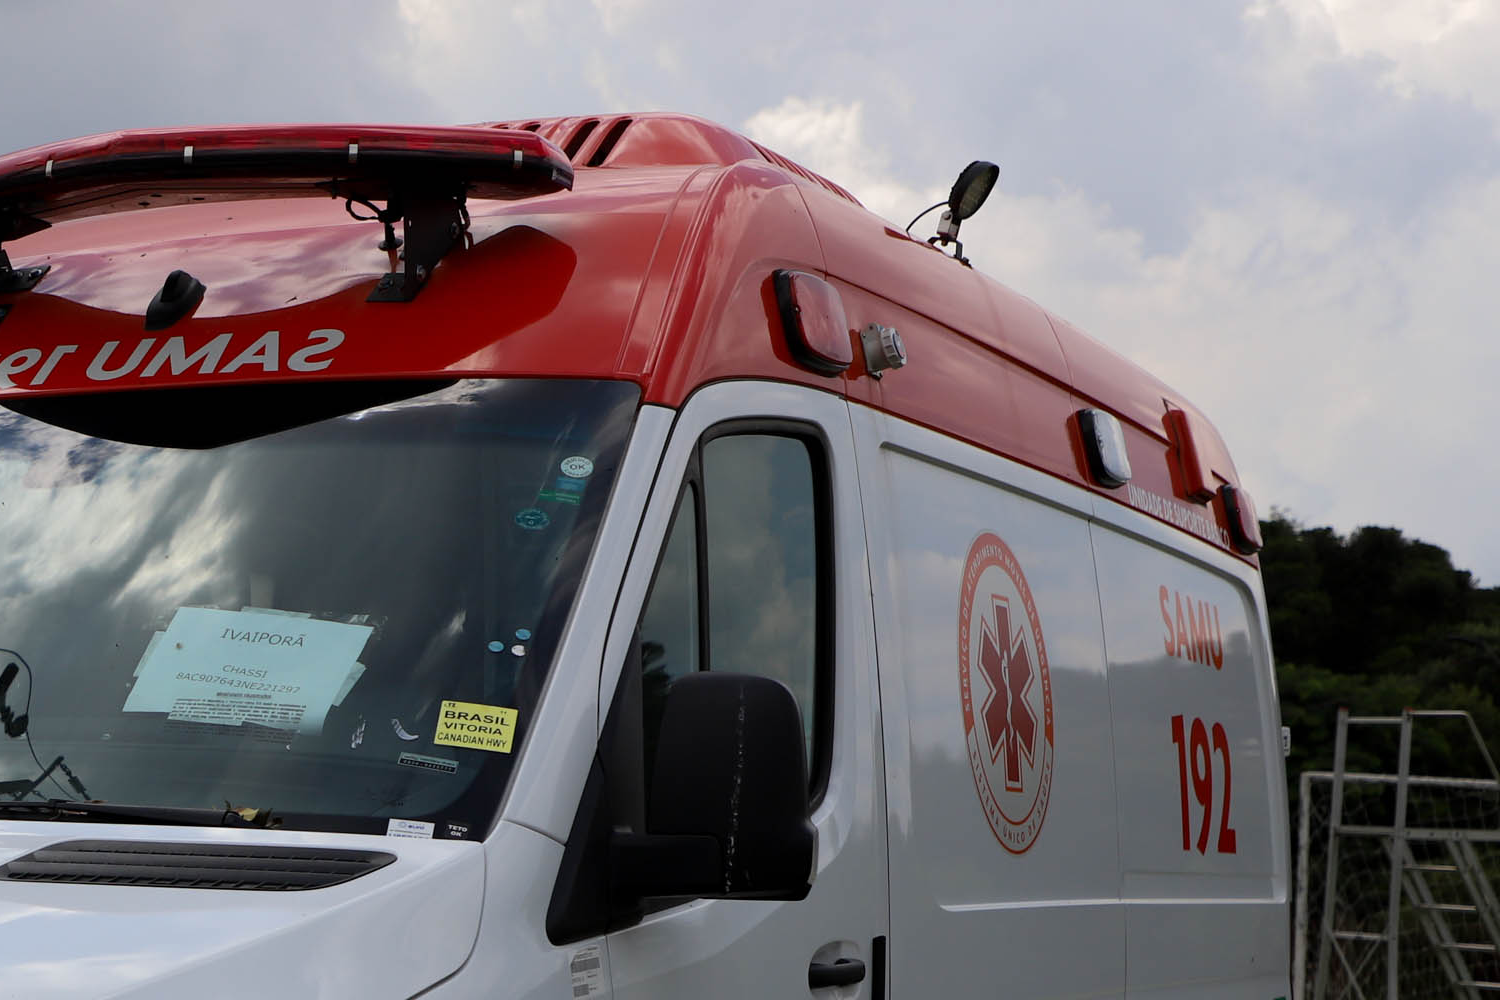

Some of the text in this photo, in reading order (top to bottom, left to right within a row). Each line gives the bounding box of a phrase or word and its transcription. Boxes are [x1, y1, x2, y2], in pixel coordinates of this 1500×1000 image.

[1158, 584, 1223, 671] SAMU
[220, 628, 306, 648] IVAIPORÃ
[222, 664, 268, 679] CHASSI
[444, 710, 509, 727] BRASIL
[444, 722, 503, 735] VITORIA
[437, 732, 507, 749] CANADIAN HWY
[1171, 714, 1237, 856] 192
